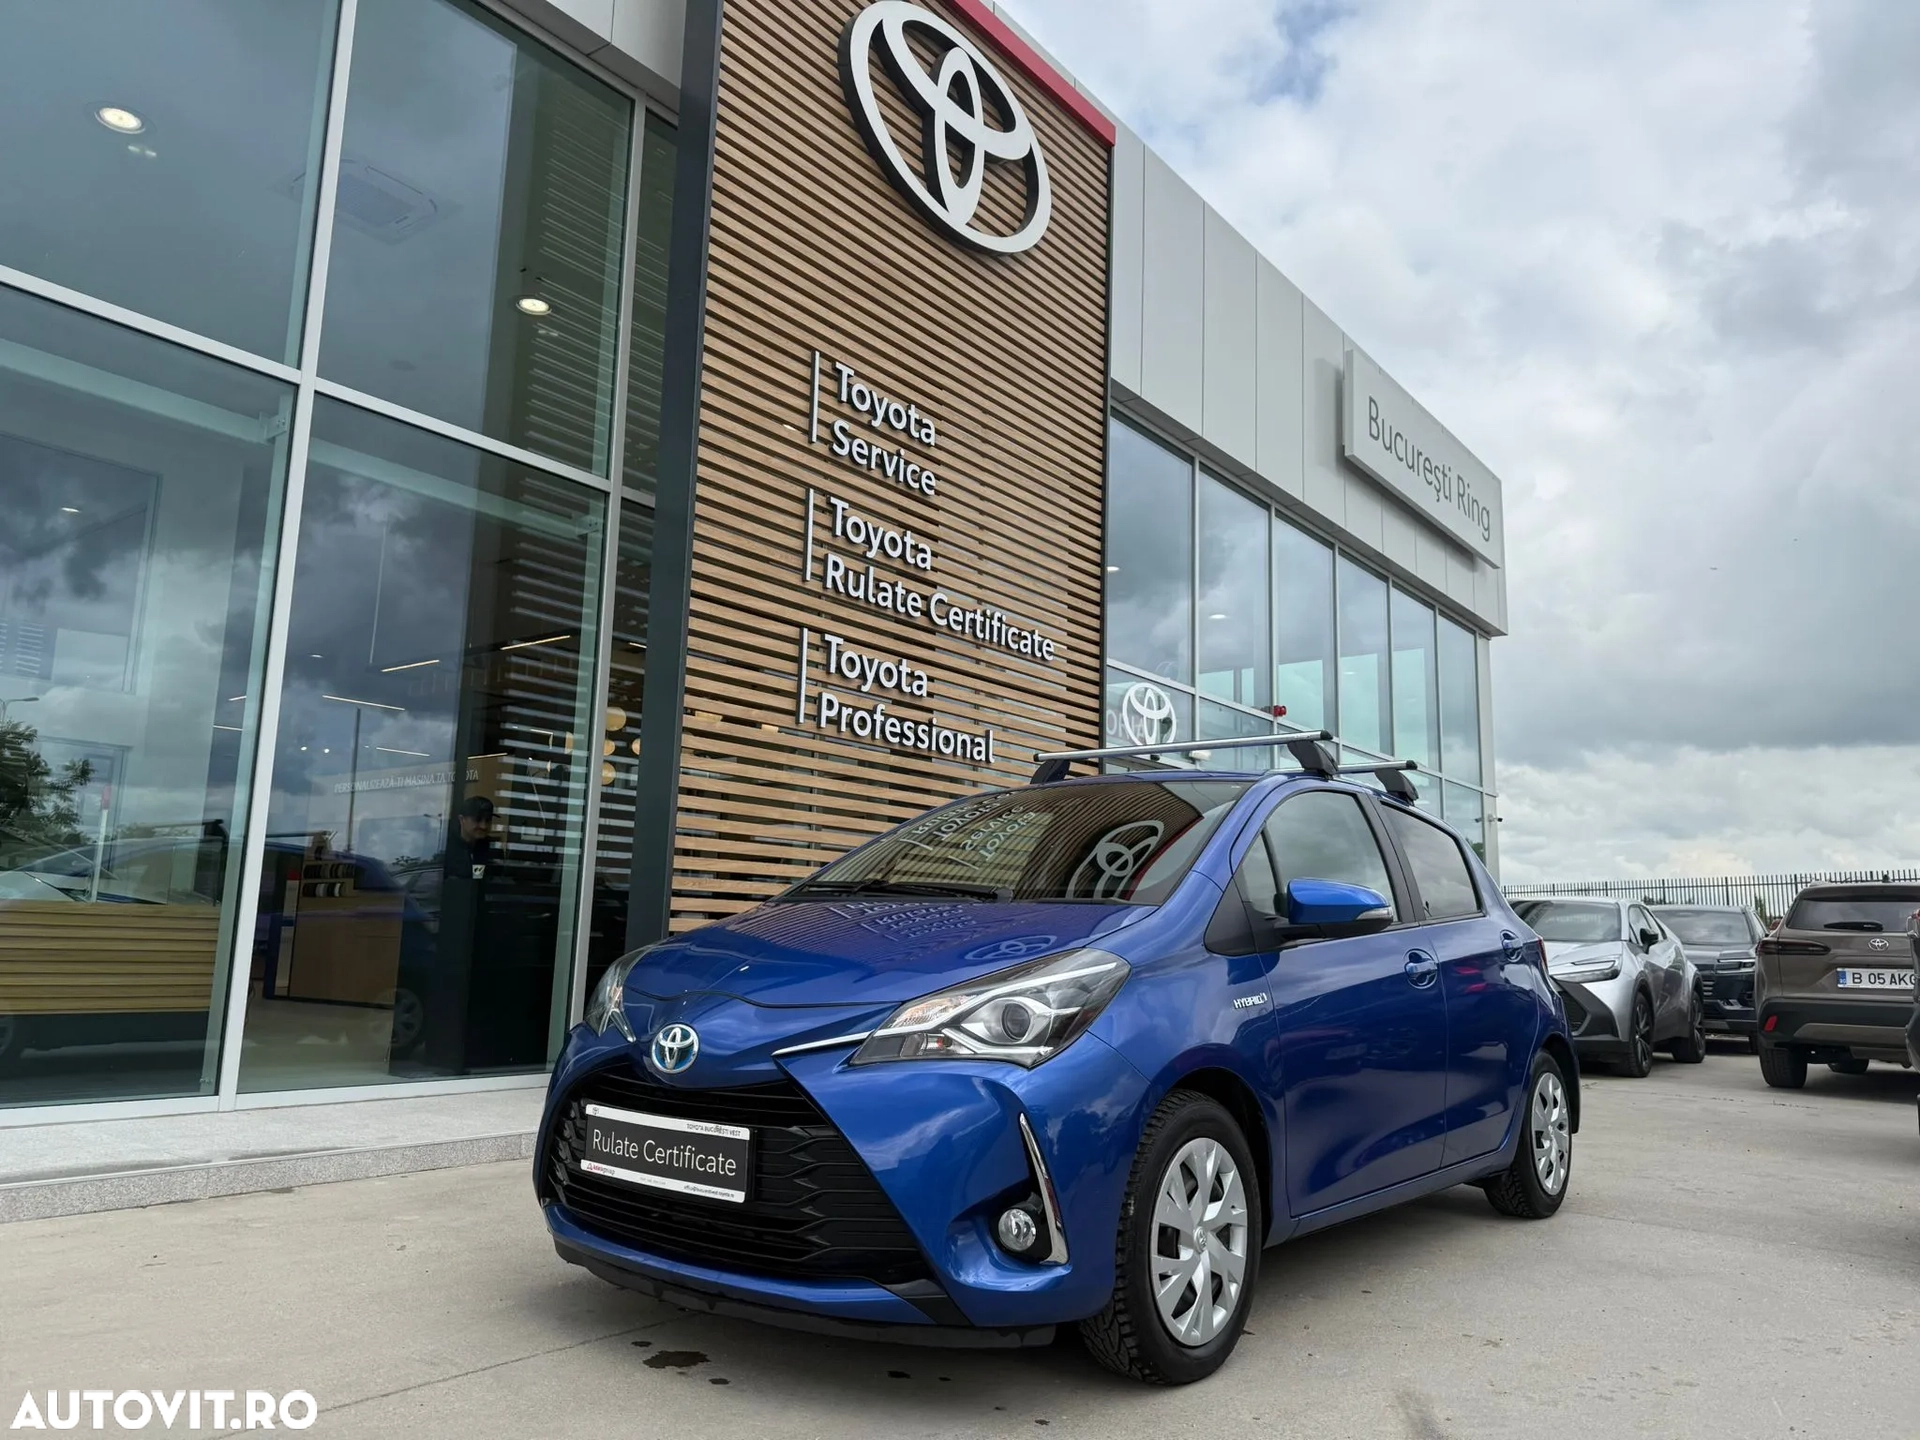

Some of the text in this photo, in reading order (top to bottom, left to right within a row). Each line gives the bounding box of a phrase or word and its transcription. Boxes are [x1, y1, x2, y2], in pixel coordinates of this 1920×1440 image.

[833, 361, 936, 447] Toyota
[830, 418, 936, 496] Service
[828, 496, 932, 571] Toyota
[1457, 474, 1491, 542] Ring
[824, 553, 1055, 661] Rulate Certificate
[822, 633, 928, 698] Toyota
[817, 692, 995, 764] Professional
[1852, 972, 1862, 984] B
[1868, 972, 1886, 985] 05
[592, 1129, 639, 1159] Rulate
[643, 1139, 737, 1176] Certificate
